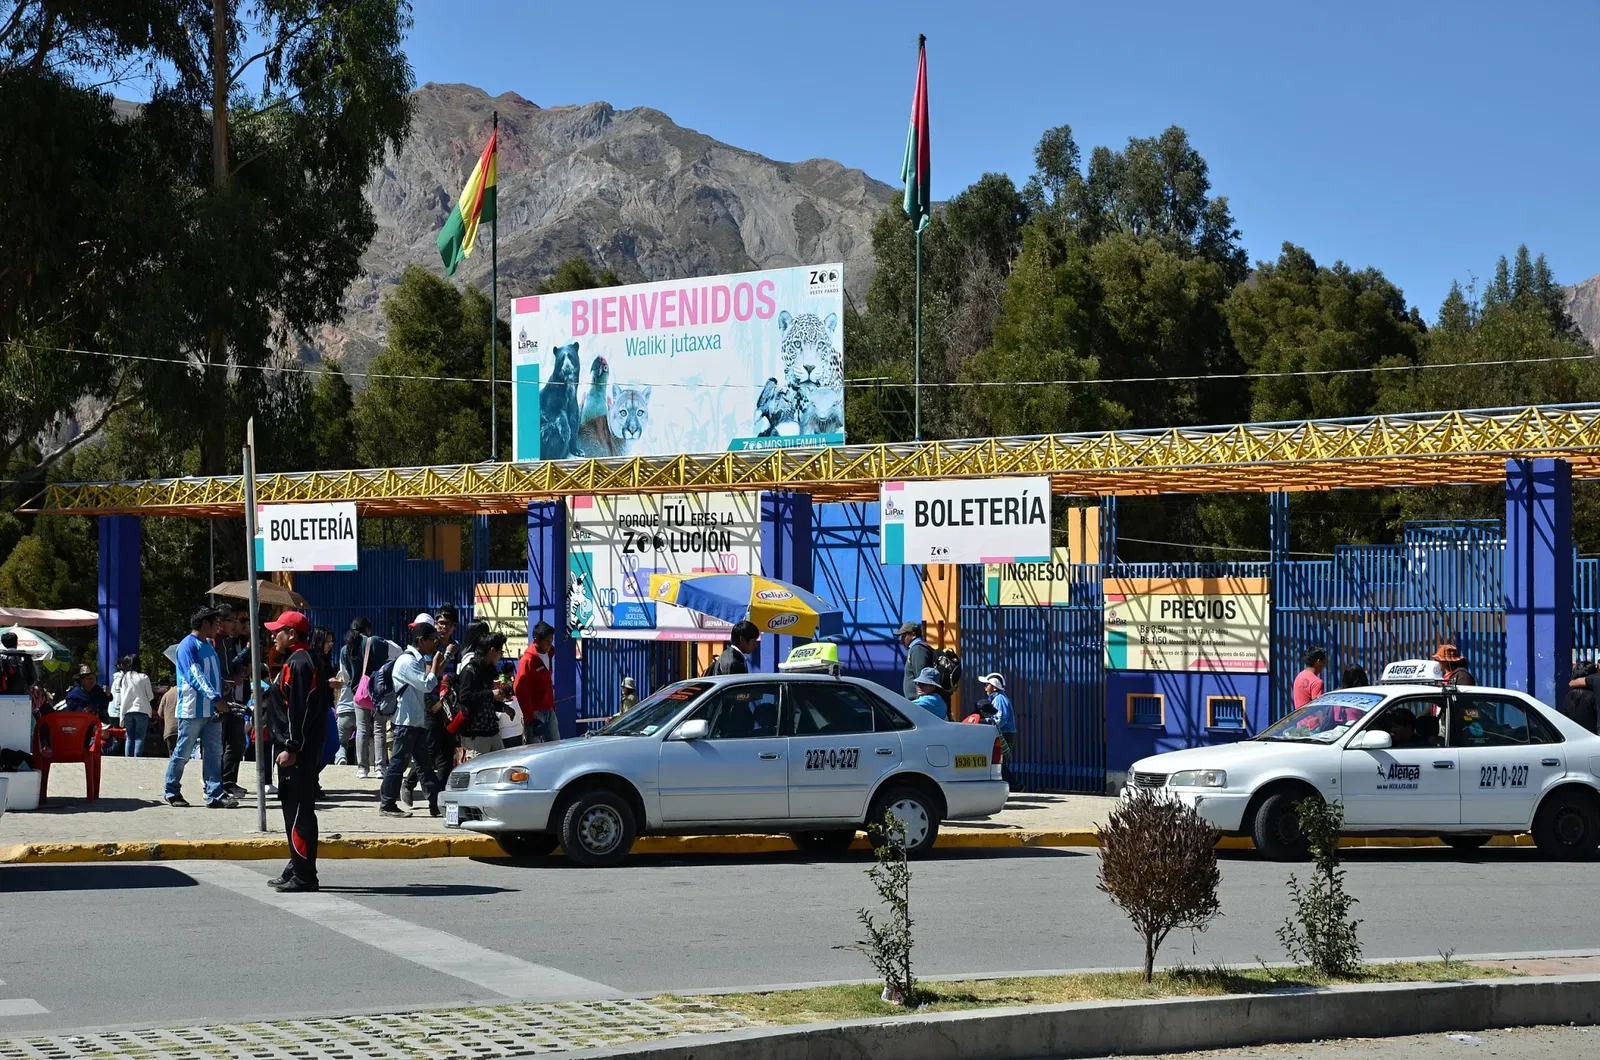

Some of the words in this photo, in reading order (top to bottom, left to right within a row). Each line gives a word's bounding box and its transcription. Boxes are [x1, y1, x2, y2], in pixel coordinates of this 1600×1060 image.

[571, 279, 776, 337] BIENVENIDOS
[625, 335, 667, 357] Waliki
[669, 332, 722, 359] jutaxxa
[784, 439, 794, 448] TU
[796, 436, 827, 448] FAMILIA
[619, 513, 658, 528] PORQUE
[664, 500, 685, 527] TÚ
[691, 512, 718, 526] ERES
[720, 512, 734, 525] LA
[885, 508, 904, 516] LaPaz
[915, 489, 1047, 528] BOLETERÍA
[270, 512, 355, 541] BOLETERÍA
[621, 555, 640, 573] NO
[719, 553, 739, 571] NO
[1003, 562, 1066, 581] INGRESO
[600, 588, 618, 607] NO
[760, 590, 790, 600] Delizia
[512, 601, 529, 617] PR
[1160, 599, 1237, 620] PRECIOS
[771, 615, 795, 628] Delizia
[1108, 617, 1127, 625] LaPaz
[1140, 625, 1150, 634] Bs
[1151, 625, 1167, 635] 3,50
[1140, 636, 1150, 645] Bs
[1151, 636, 1167, 646] 1,50
[1387, 664, 1419, 675] Atenea
[805, 748, 860, 770] 227-0-227
[1387, 763, 1420, 780] Atenea
[1479, 764, 1530, 789] 227-0-227
